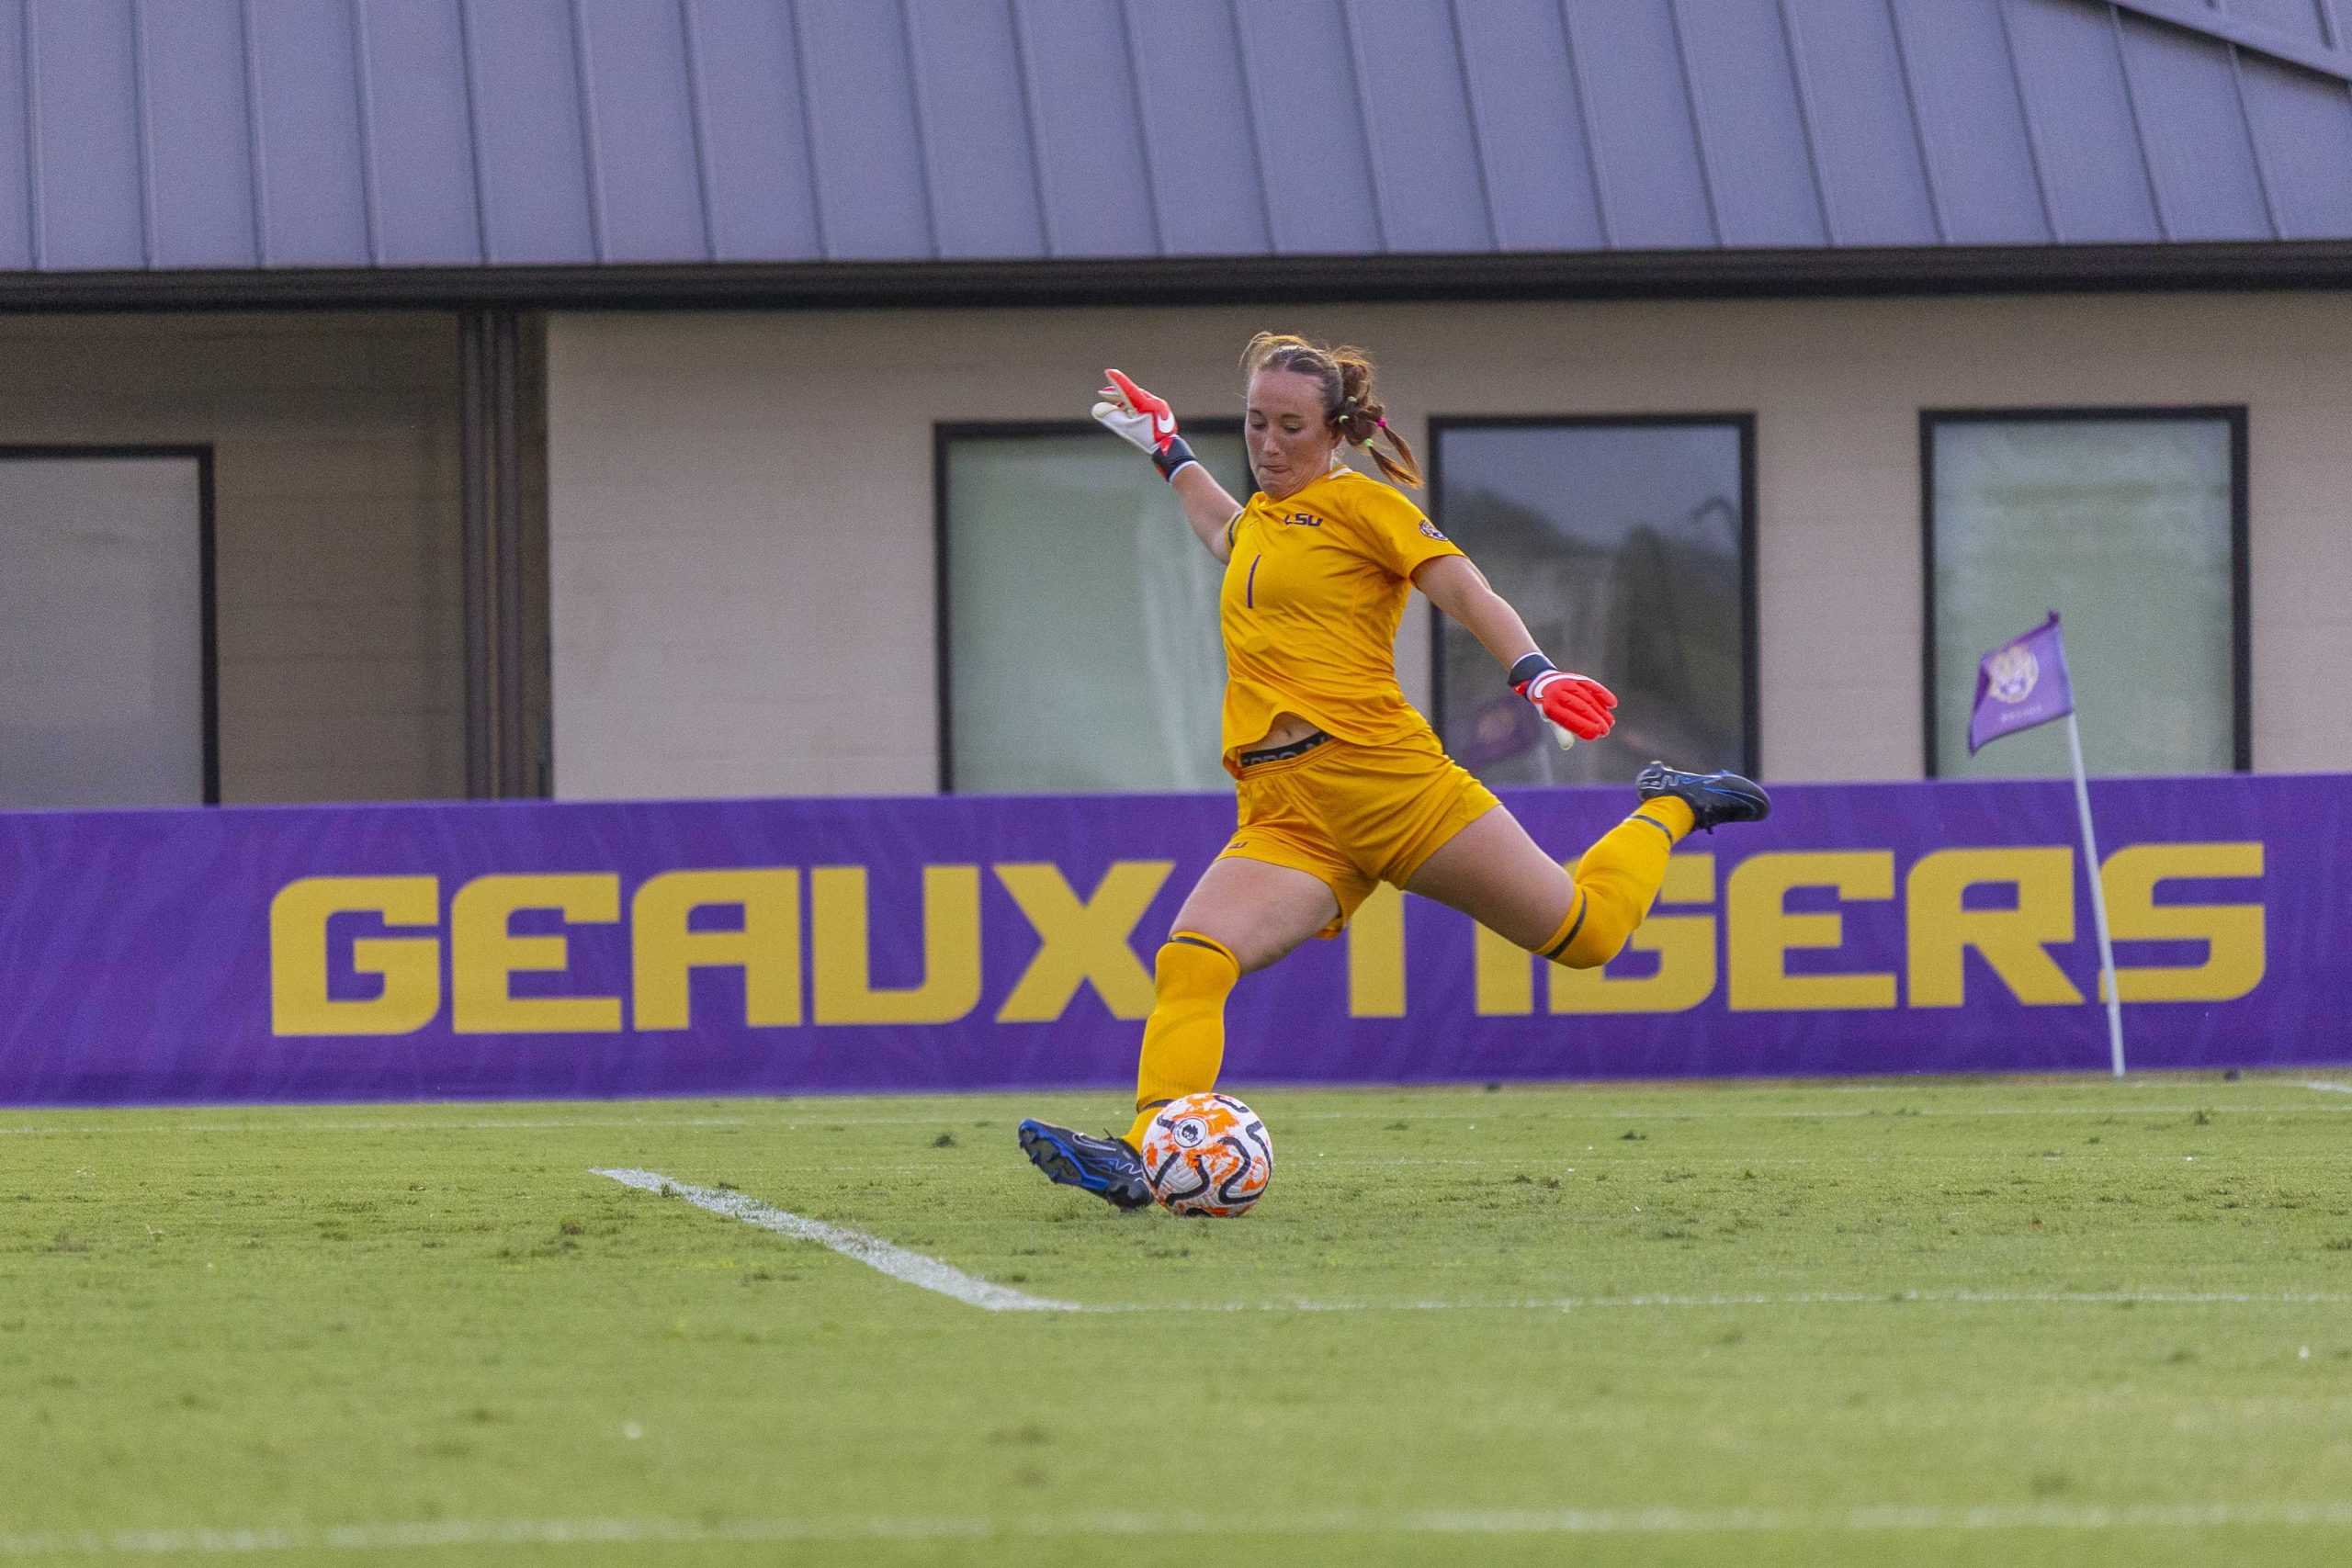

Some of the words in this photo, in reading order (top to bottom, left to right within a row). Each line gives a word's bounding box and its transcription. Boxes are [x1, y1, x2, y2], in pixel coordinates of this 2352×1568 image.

[1284, 513, 1323, 526] LSU
[1247, 554, 1261, 609] 1
[270, 861, 1173, 1037] GEAUX
